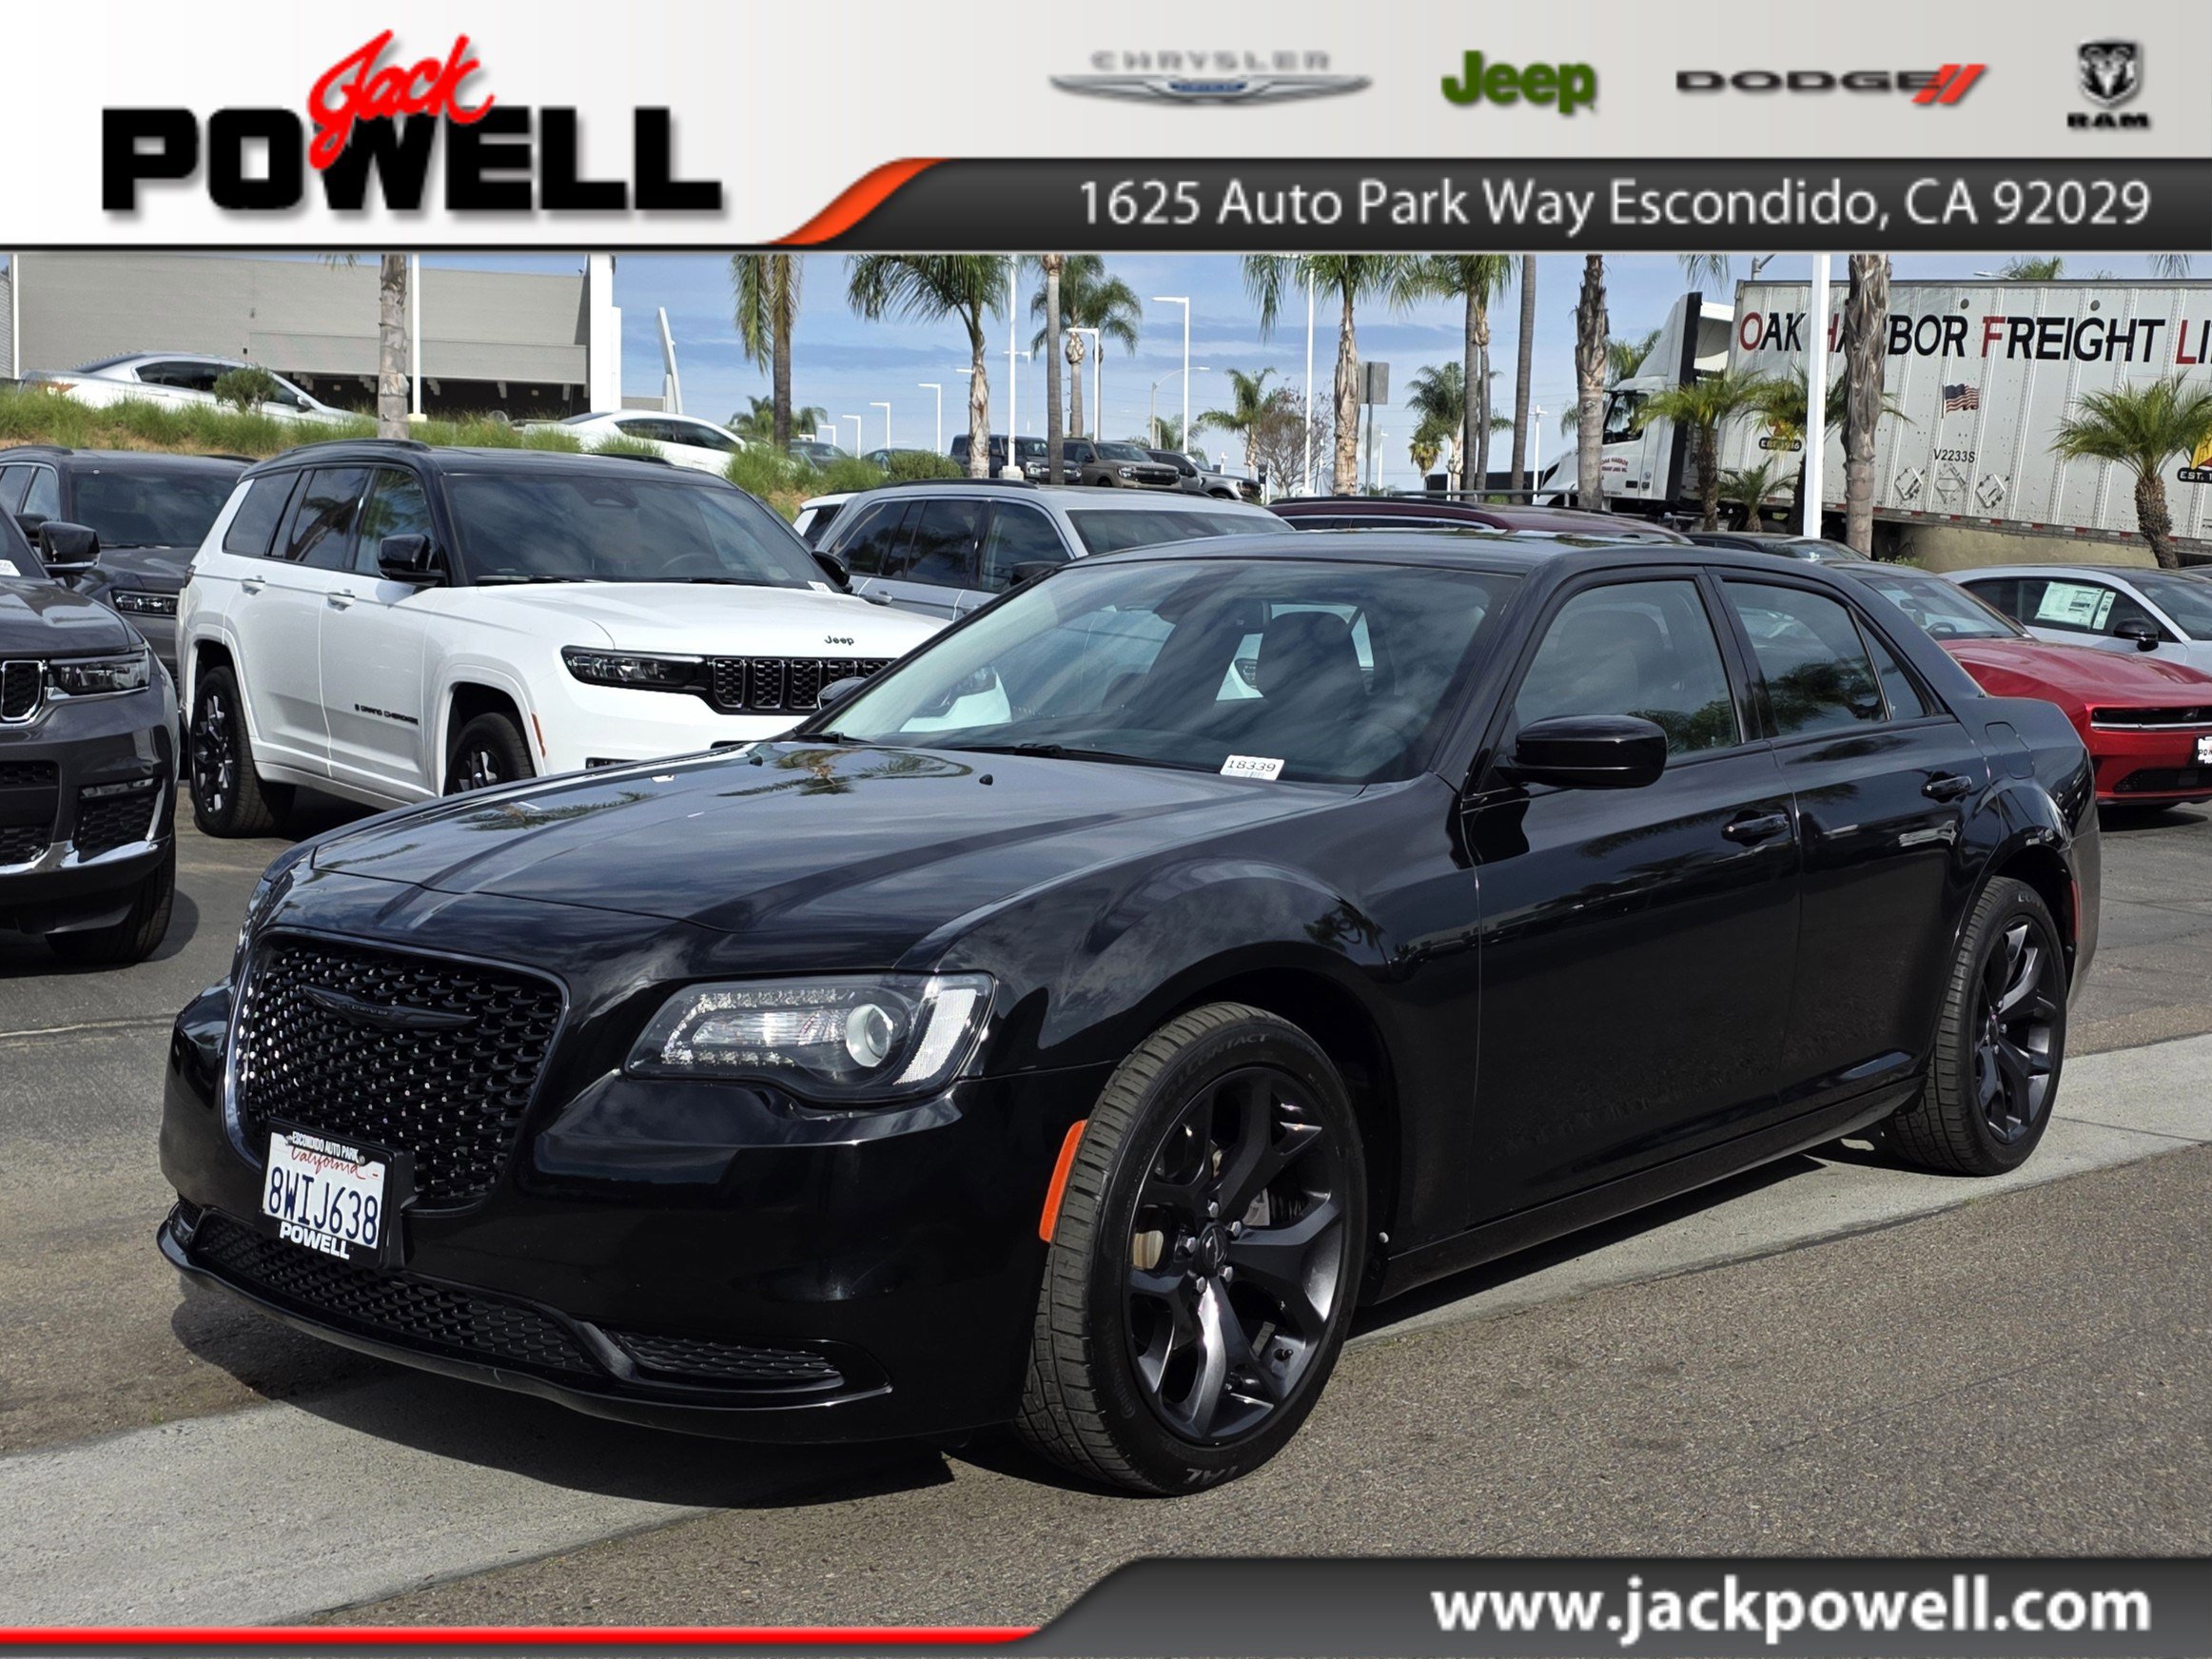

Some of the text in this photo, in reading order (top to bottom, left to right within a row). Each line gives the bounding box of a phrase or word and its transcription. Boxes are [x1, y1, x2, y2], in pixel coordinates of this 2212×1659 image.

[1739, 312, 2212, 364] OAK HBOR FREIGHT LI
[2180, 471, 2204, 481] EST.
[824, 634, 854, 646] Jeep
[1227, 760, 1276, 772] 18339
[324, 1141, 341, 1157] AUTO
[291, 1145, 366, 1181] California
[269, 1166, 378, 1245] 8WIJ638
[279, 1221, 350, 1259] POWELL
